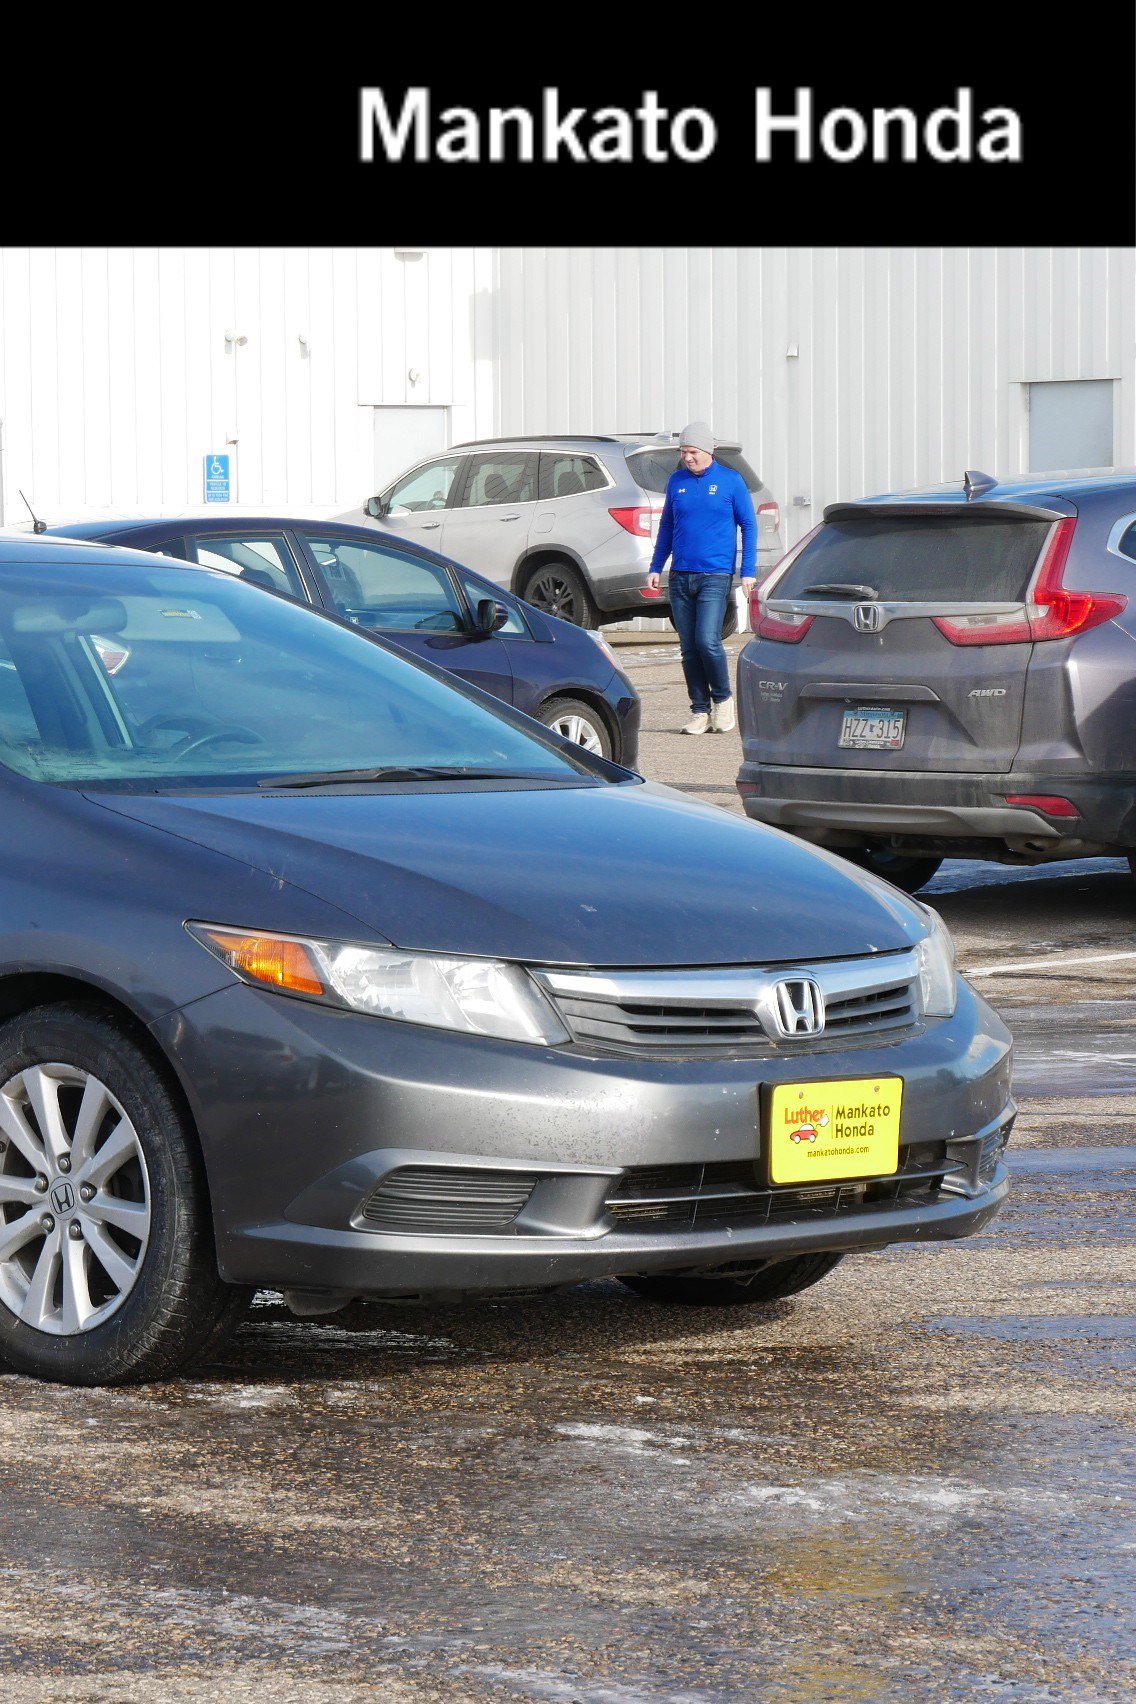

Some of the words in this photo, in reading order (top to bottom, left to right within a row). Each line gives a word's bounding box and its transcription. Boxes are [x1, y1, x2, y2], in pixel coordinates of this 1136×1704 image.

[758, 680, 789, 691] CR-V
[966, 688, 1007, 697] AWD
[843, 717, 869, 738] HZZ
[876, 718, 901, 739] 315
[784, 1106, 826, 1125] Luther
[835, 1103, 891, 1120] Mankato
[835, 1121, 875, 1139] Honda
[807, 1146, 870, 1158] mankatohonda.com
